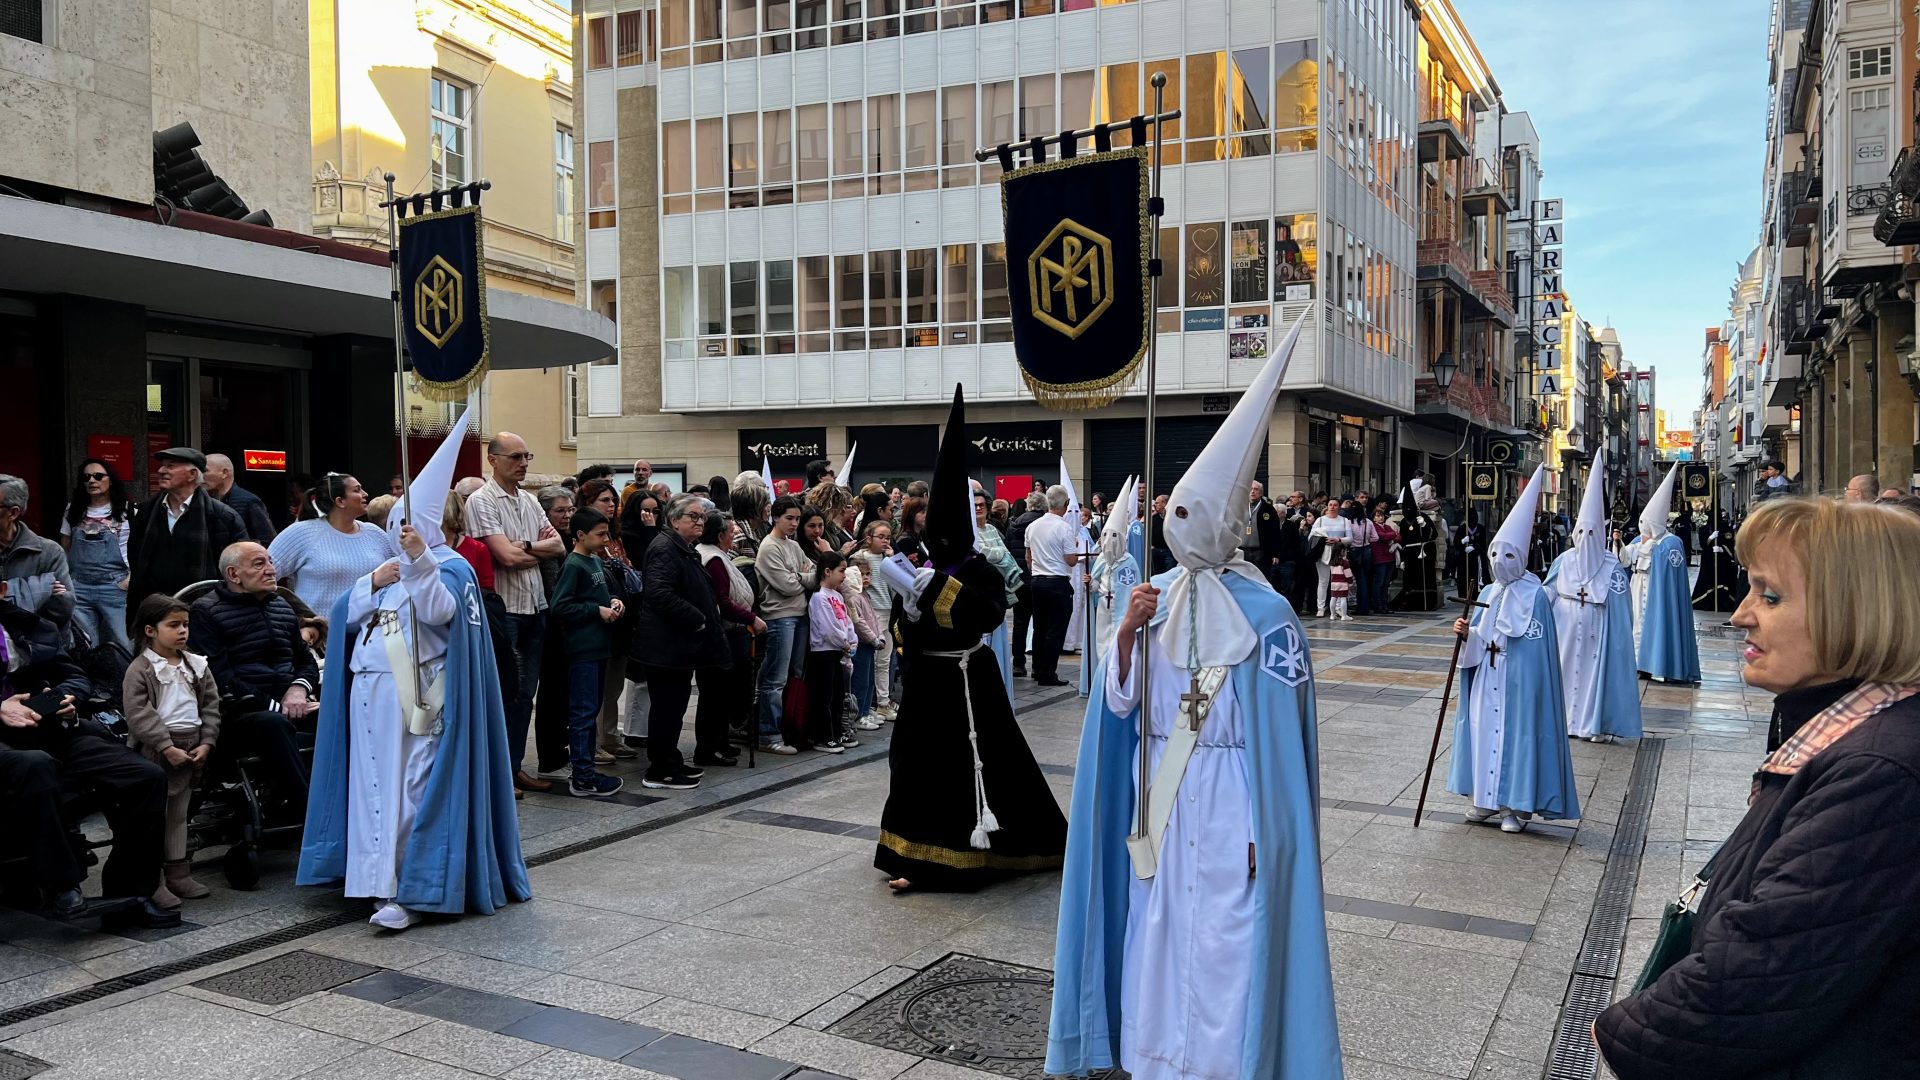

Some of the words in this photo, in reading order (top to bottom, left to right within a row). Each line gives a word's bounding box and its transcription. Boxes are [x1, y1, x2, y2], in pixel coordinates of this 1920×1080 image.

[1255, 240, 1266, 292] estilistas
[1541, 200, 1560, 393] FARMACIA
[762, 443, 819, 457] Occident
[989, 437, 1053, 452] Occident
